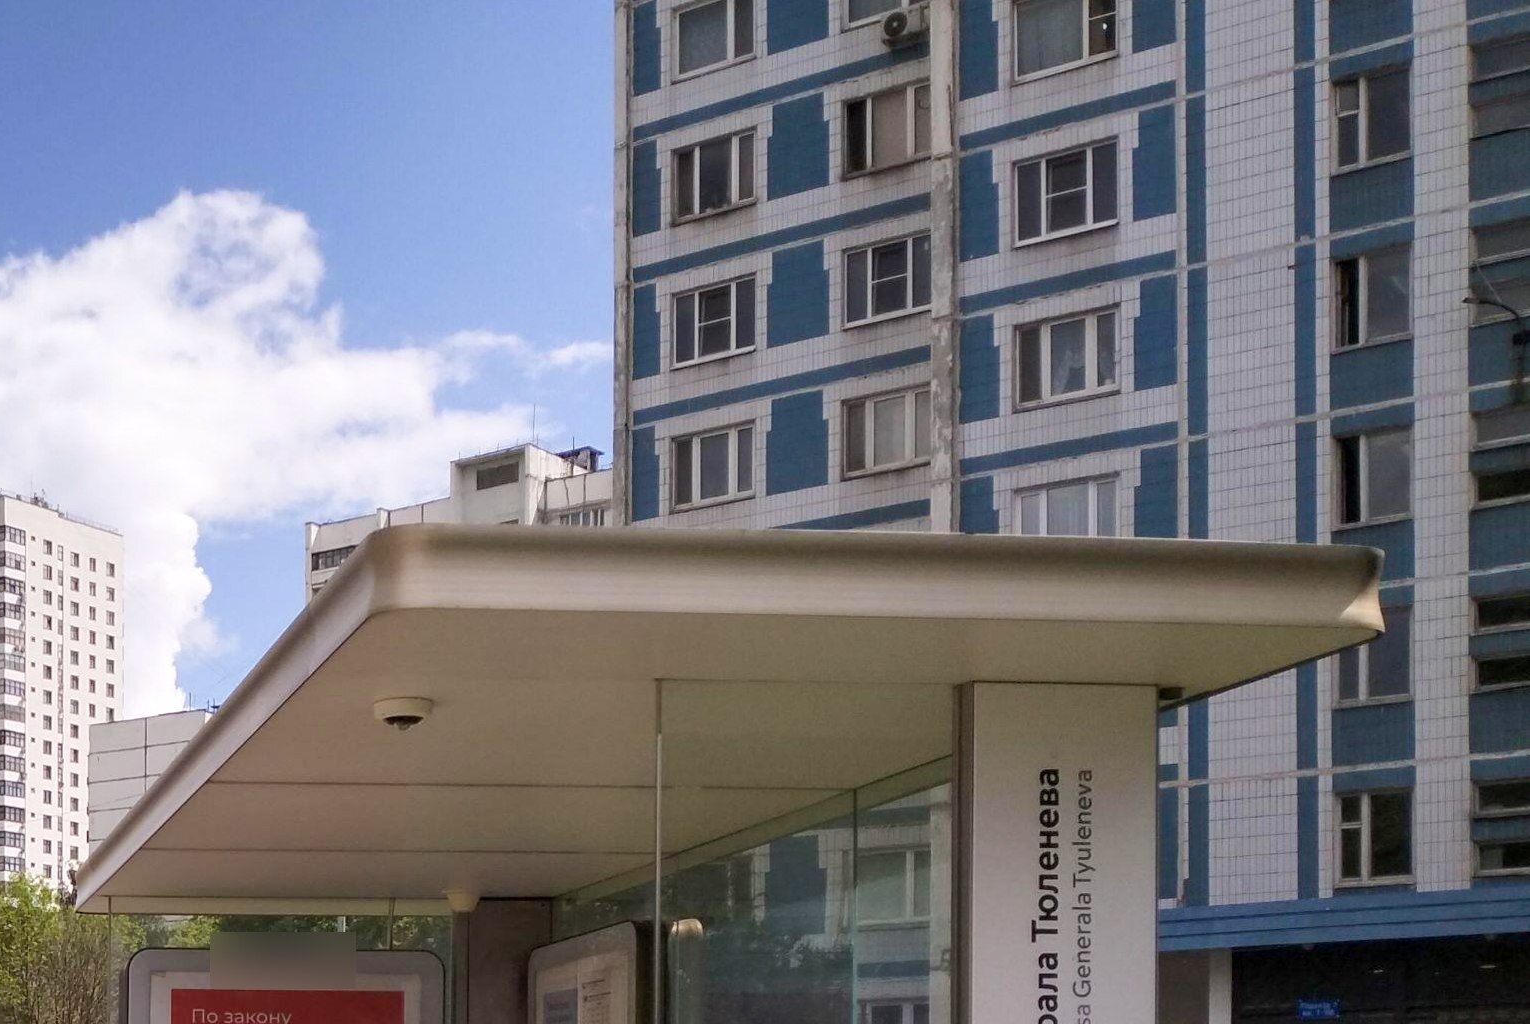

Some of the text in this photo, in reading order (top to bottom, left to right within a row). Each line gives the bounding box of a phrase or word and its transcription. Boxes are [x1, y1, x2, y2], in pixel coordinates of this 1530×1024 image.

[1030, 768, 1060, 944] Тюленева
[1072, 769, 1097, 887] Tyuleneva
[1072, 891, 1093, 999] Generala
[191, 1008, 218, 1024] По
